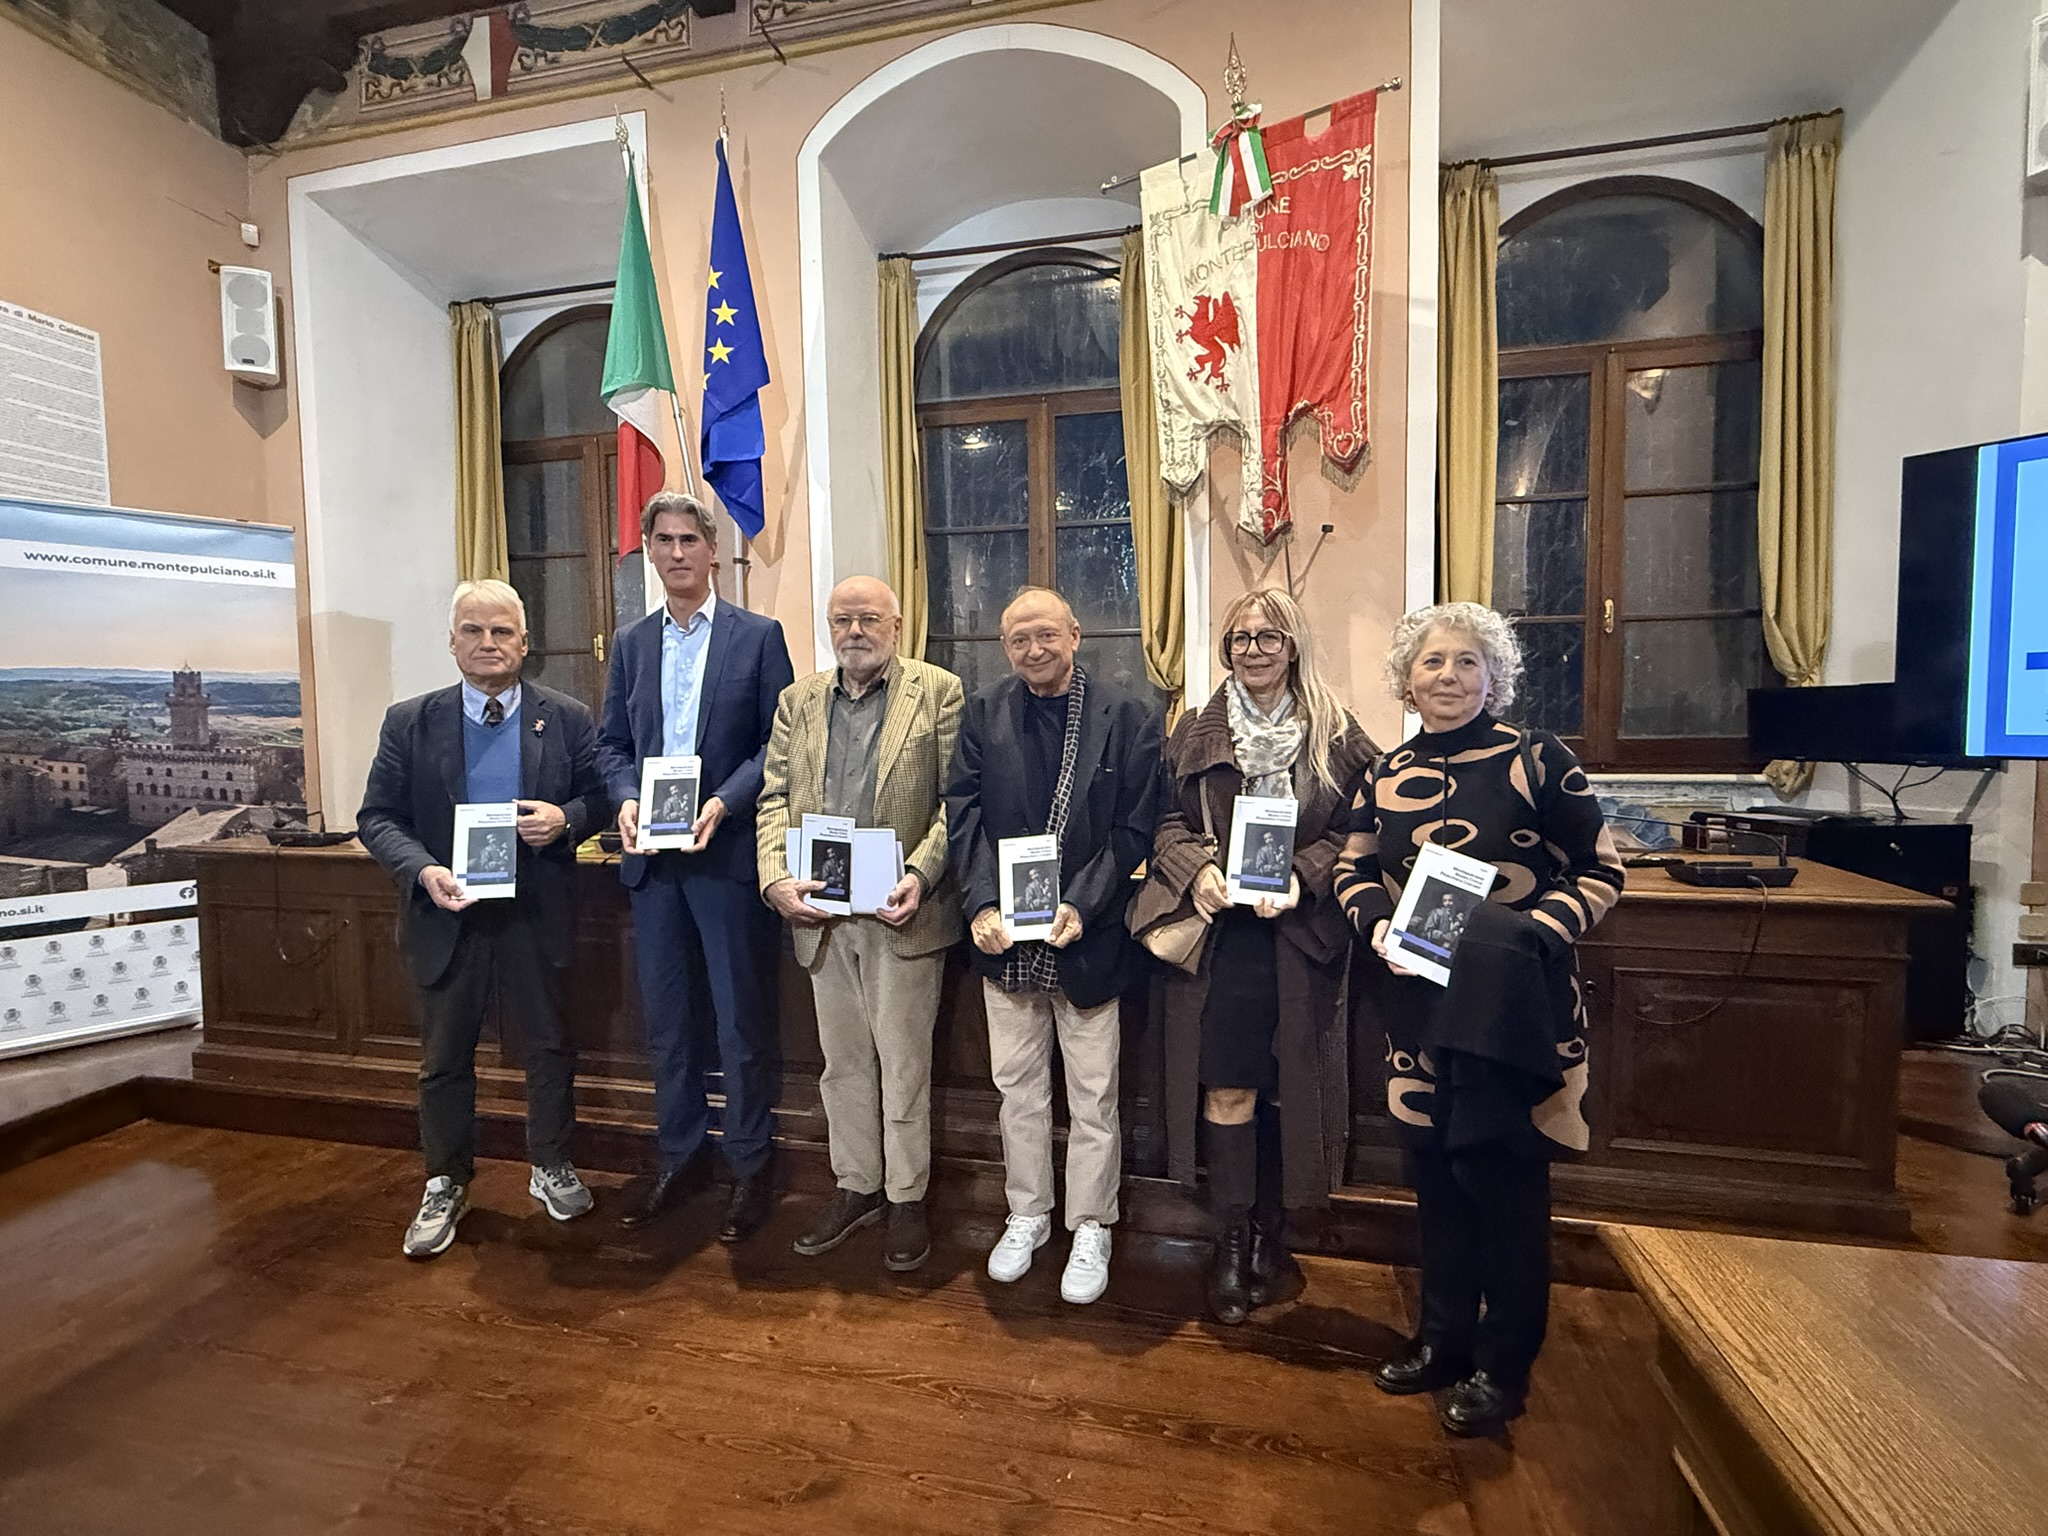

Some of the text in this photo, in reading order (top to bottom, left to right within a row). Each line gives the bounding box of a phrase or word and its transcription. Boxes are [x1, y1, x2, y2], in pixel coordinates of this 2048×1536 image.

[1184, 230, 1331, 288] MONTEPULCIANO
[28, 313, 54, 328] Mario
[23, 551, 276, 580] www.comune.montepulciano.si.it
